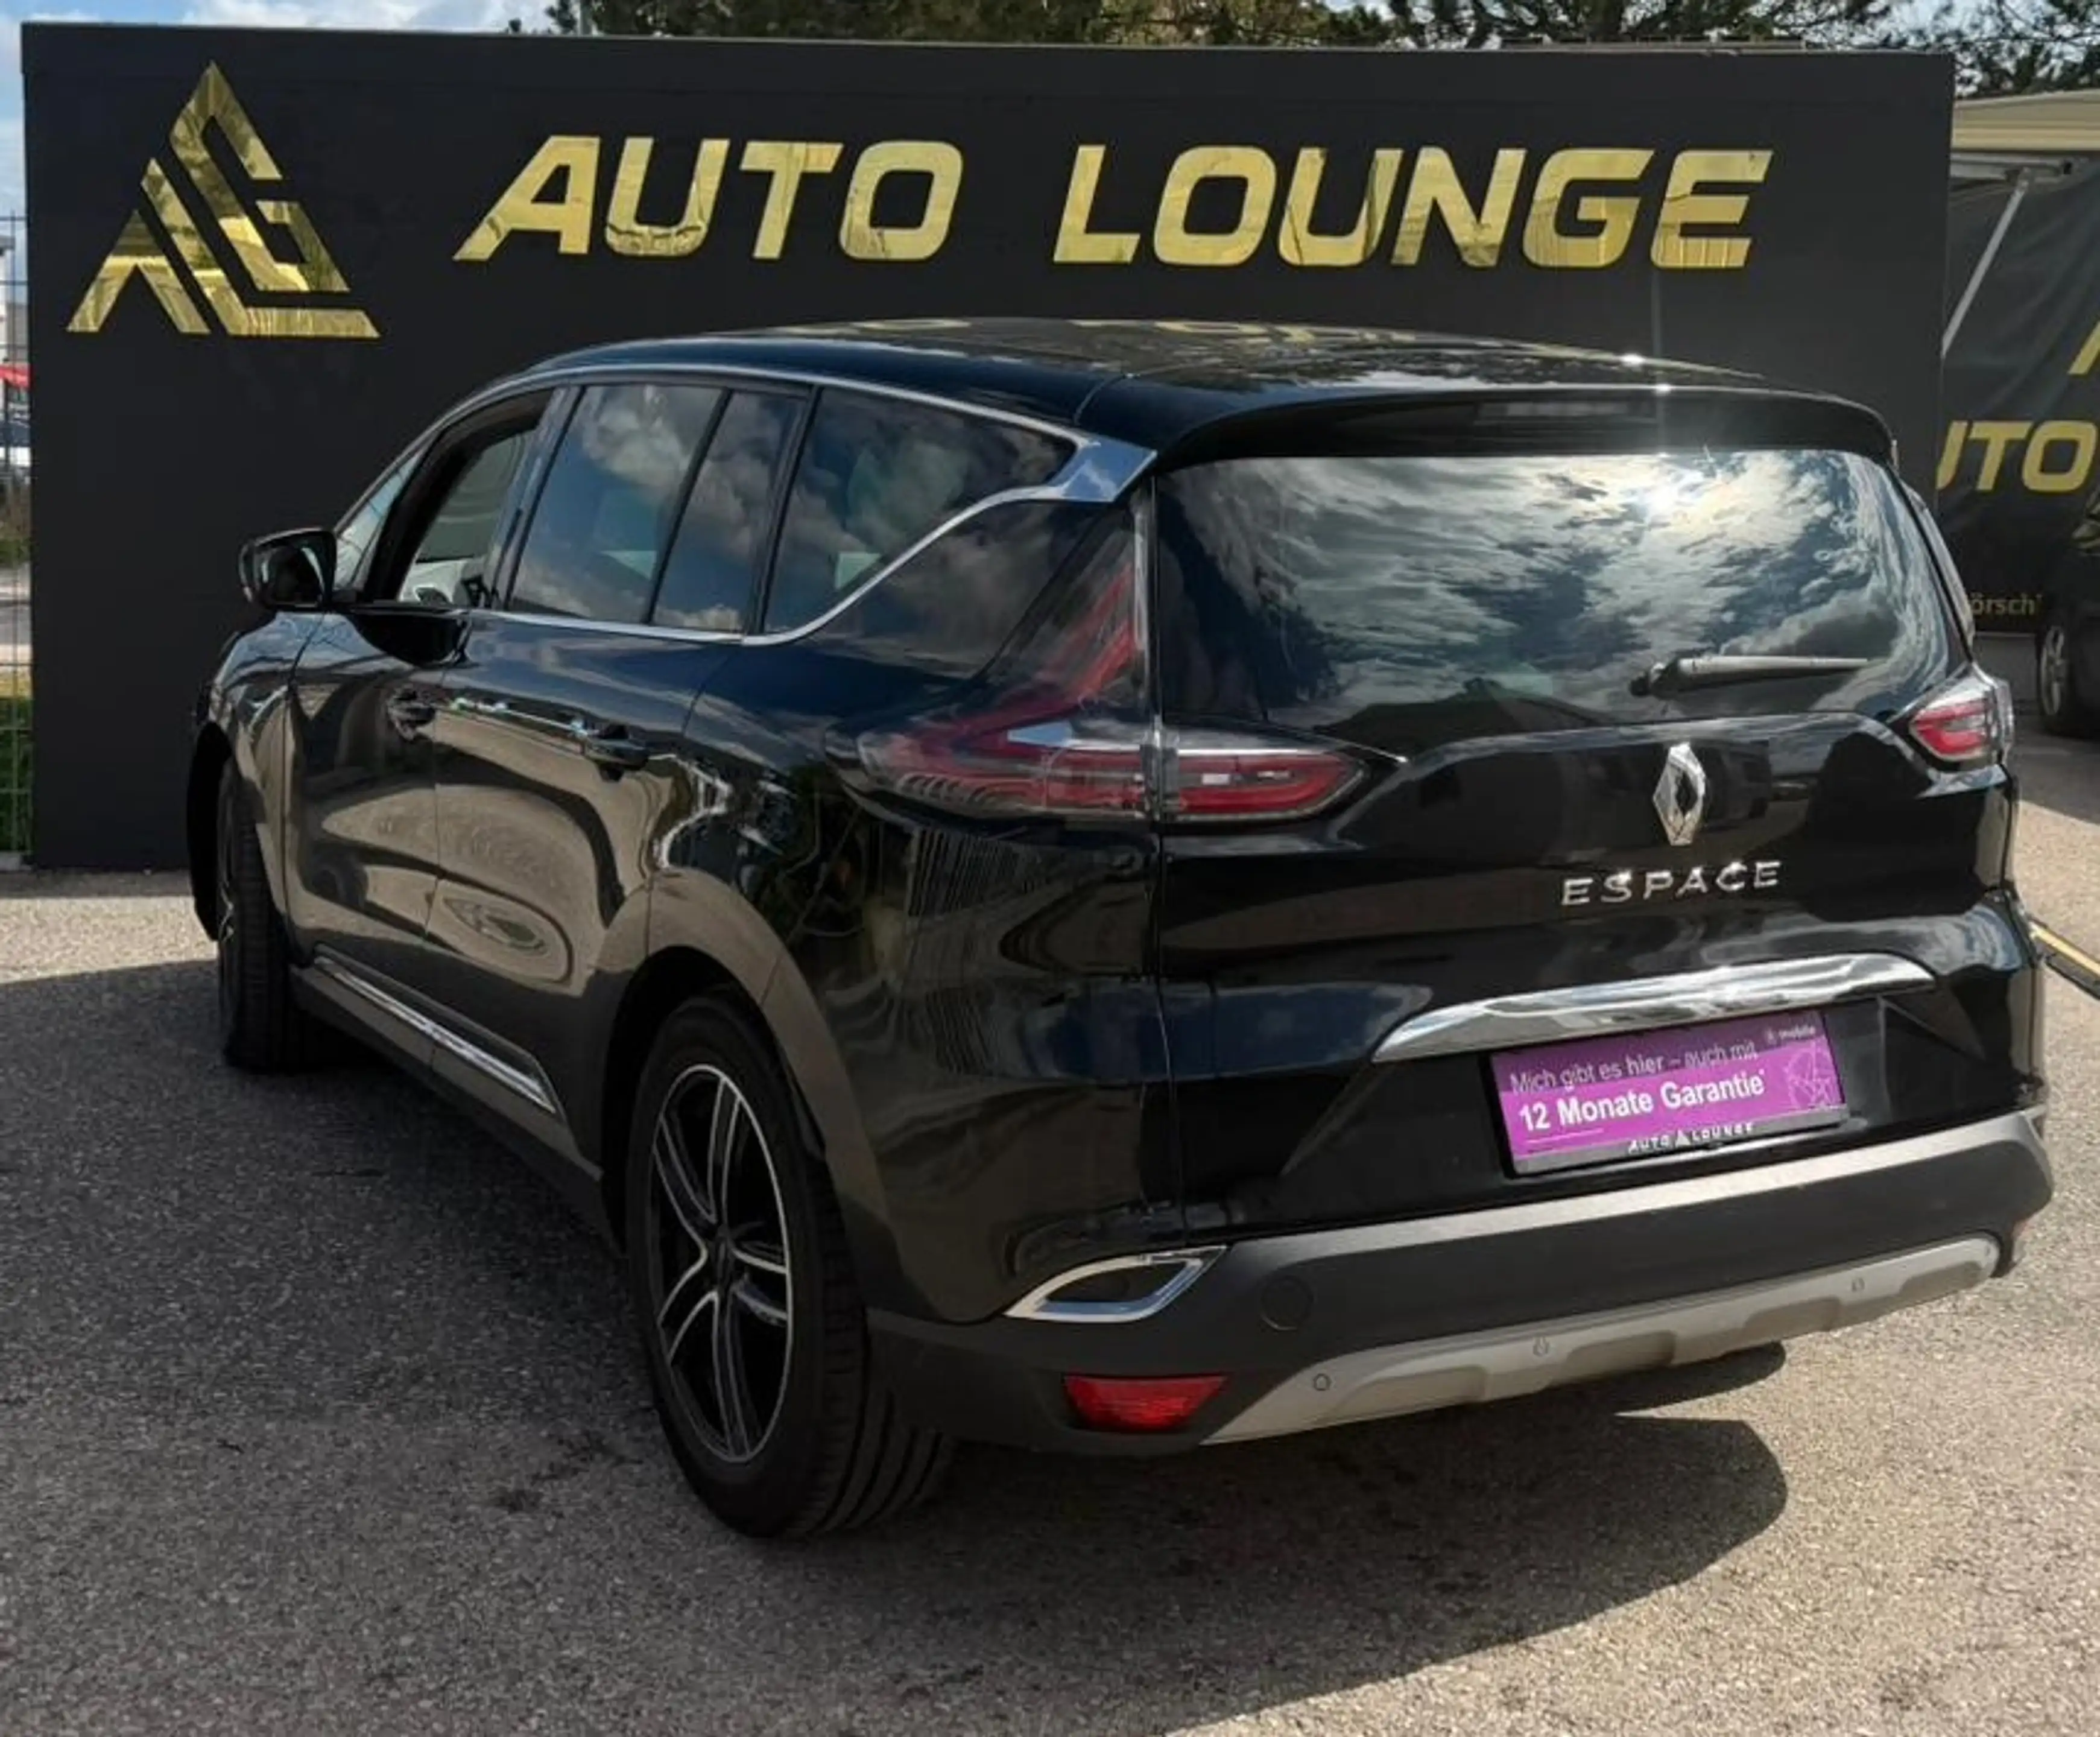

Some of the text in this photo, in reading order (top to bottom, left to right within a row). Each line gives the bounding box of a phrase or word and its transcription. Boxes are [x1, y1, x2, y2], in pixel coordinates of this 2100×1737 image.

[452, 135, 1774, 268] AUTO LOUNGE
[1561, 860, 1782, 905] ESPACE
[1510, 1068, 1557, 1096] Mich
[1560, 1062, 1595, 1092] gibt
[1599, 1062, 1622, 1080] es
[1625, 1053, 1665, 1076] hier
[1684, 1042, 1726, 1069] auch
[1518, 1101, 1551, 1131] 12
[1557, 1088, 1654, 1125] Monate
